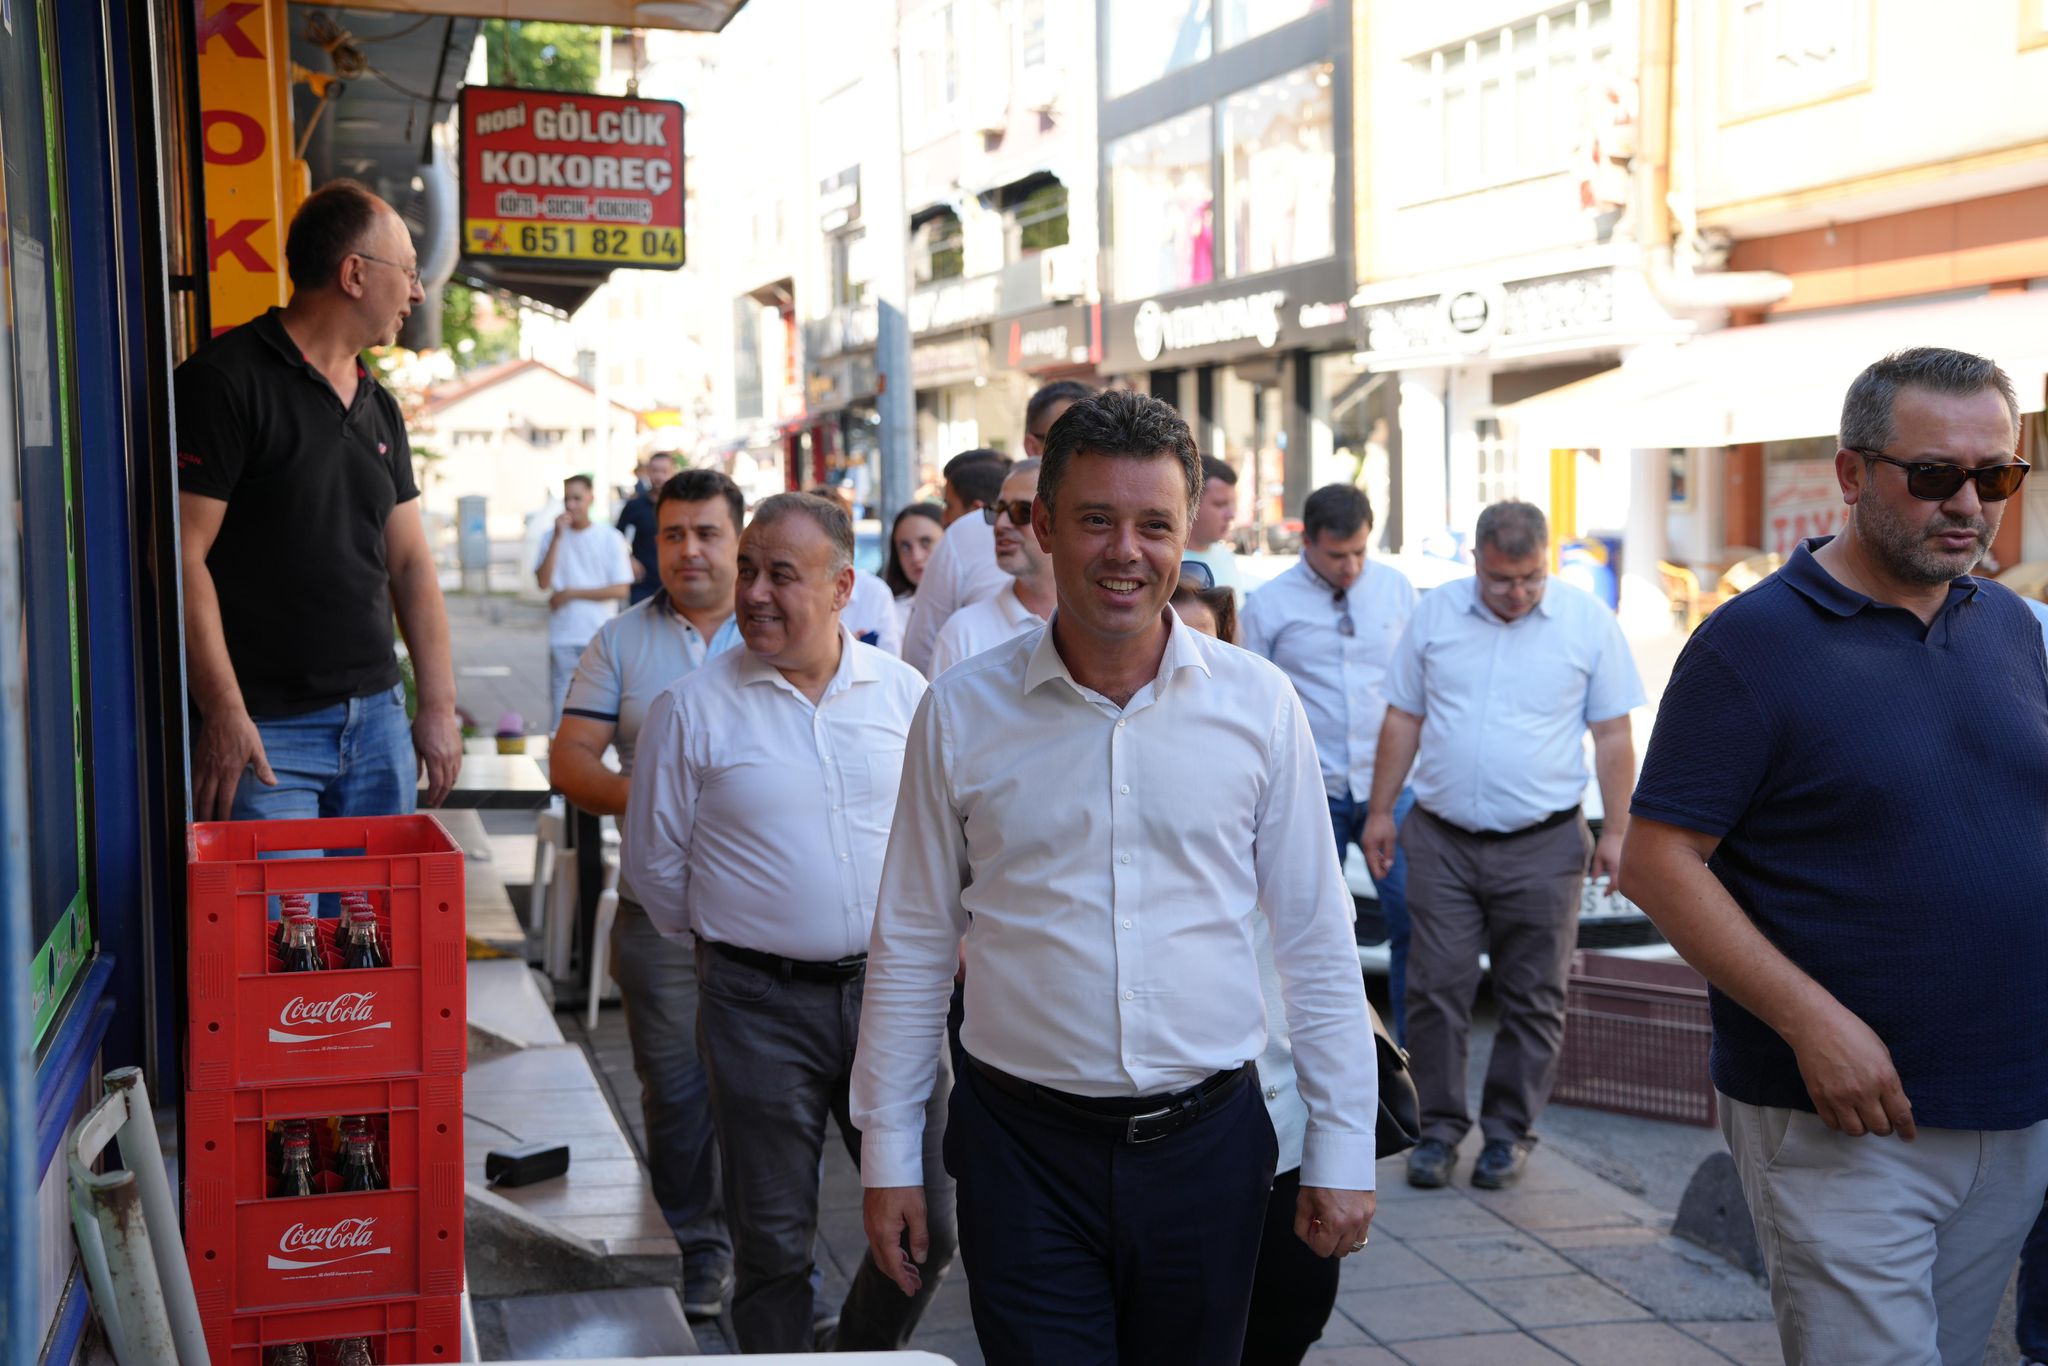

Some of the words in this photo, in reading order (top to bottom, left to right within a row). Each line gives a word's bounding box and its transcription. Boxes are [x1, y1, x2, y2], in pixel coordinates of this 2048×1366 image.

[533, 103, 667, 147] GÖLCÜK
[480, 150, 673, 196] KOKOREÇ
[520, 226, 576, 254] 651
[592, 229, 629, 255] 82
[642, 230, 678, 258] 04
[280, 991, 378, 1026] Coca-Cola
[279, 1216, 378, 1253] Coca-Cola
